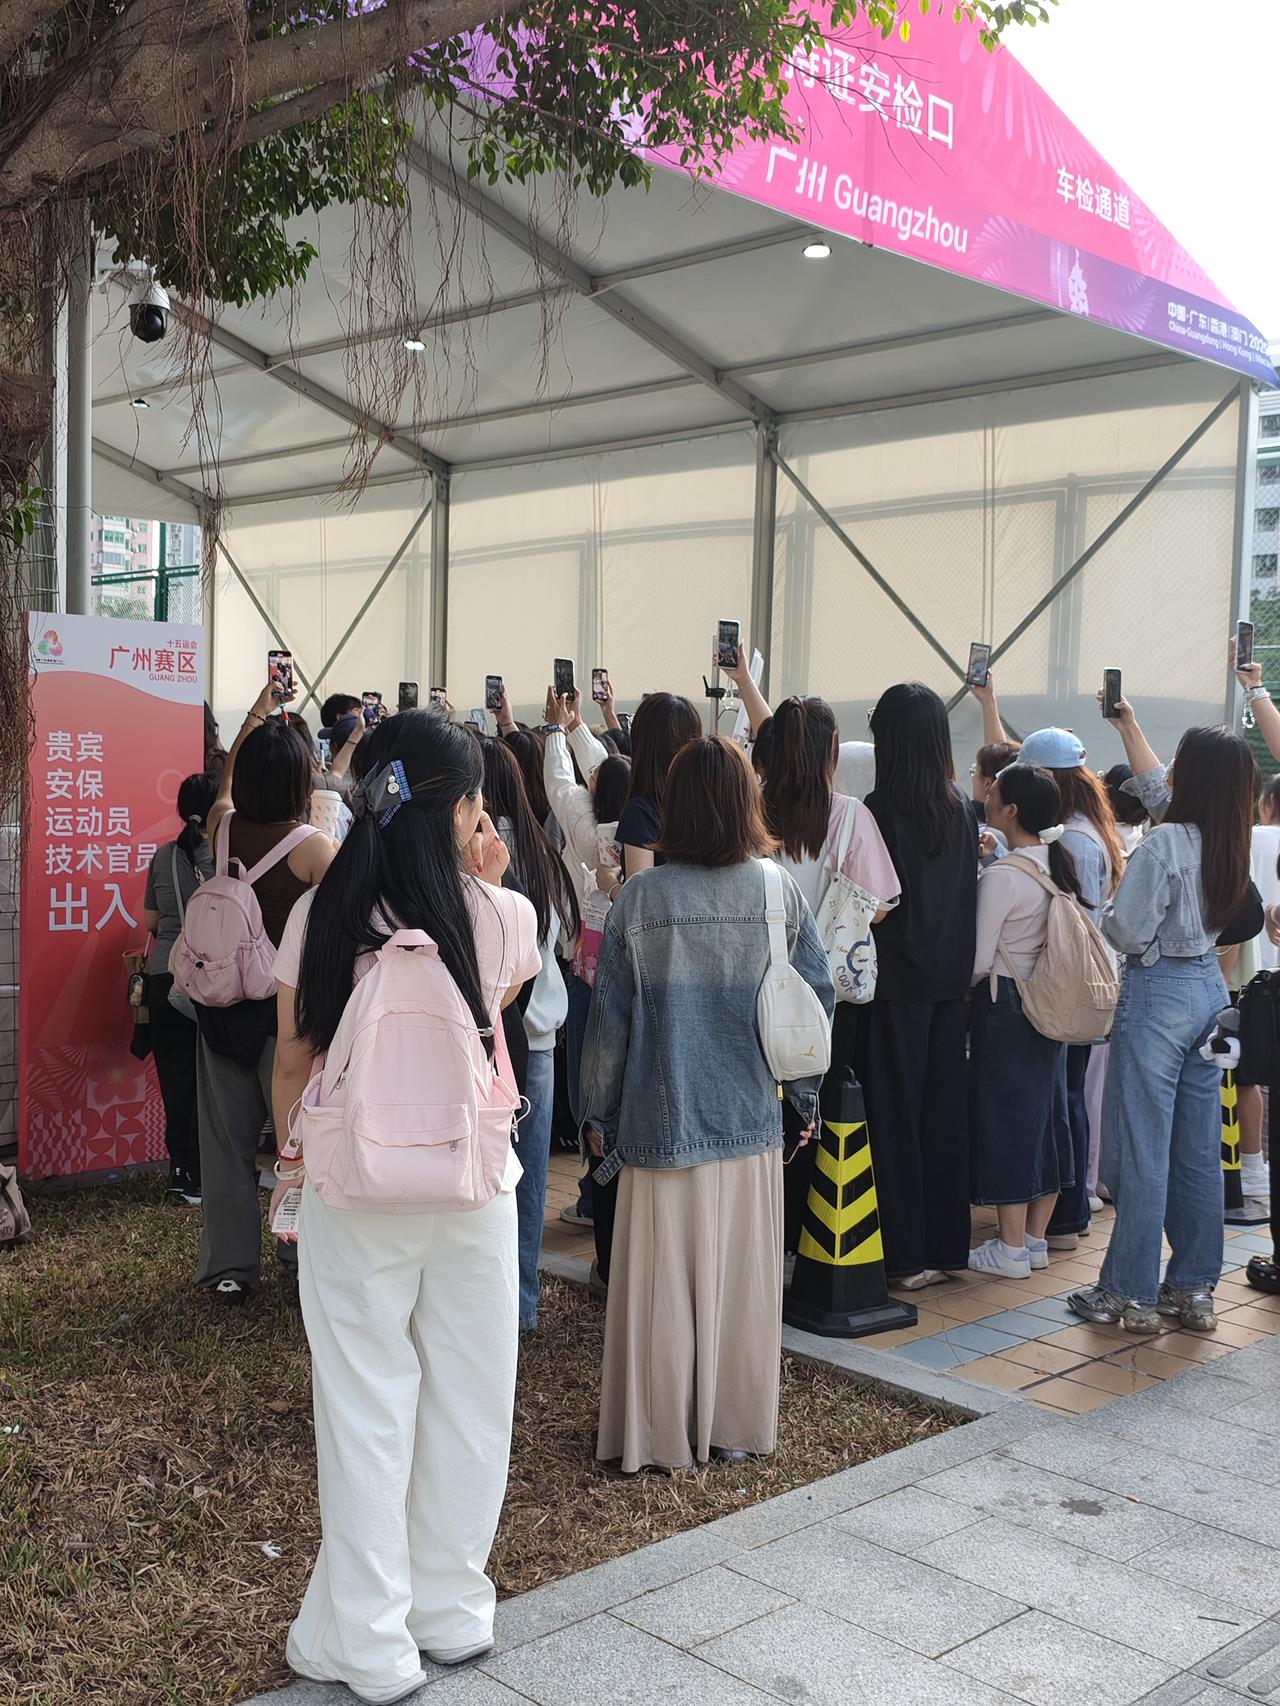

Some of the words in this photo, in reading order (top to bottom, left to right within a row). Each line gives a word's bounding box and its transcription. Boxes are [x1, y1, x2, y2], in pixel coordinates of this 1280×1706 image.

[766, 146, 828, 203] 广州
[834, 174, 968, 253] Guangzhou
[1056, 165, 1130, 230] 车检通道
[108, 645, 197, 674] 广州赛区
[167, 639, 198, 649] 十五运会
[149, 673, 175, 683] GUANG
[177, 674, 198, 684] ZHOU
[45, 730, 104, 763] 贵宾
[45, 768, 104, 800] 安保
[45, 806, 132, 838] 运动员
[45, 842, 158, 875] 技术官员
[49, 882, 138, 933] 出入
